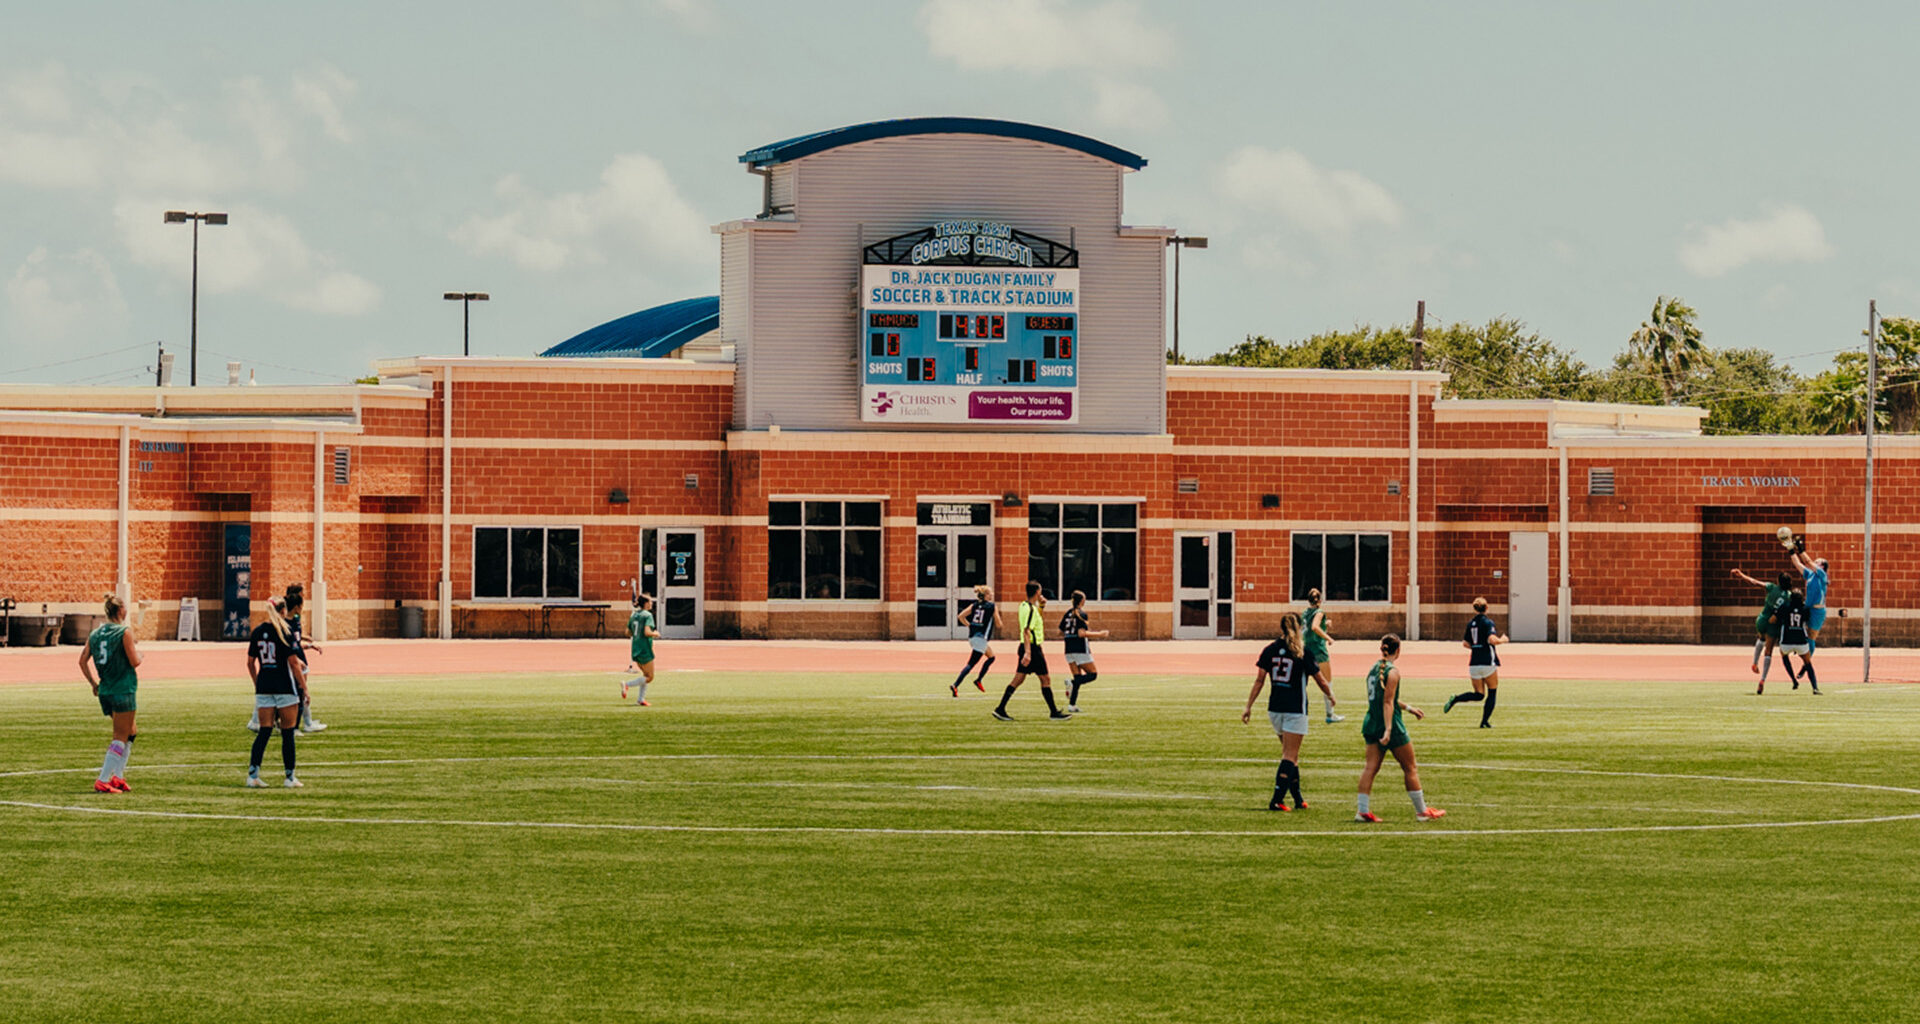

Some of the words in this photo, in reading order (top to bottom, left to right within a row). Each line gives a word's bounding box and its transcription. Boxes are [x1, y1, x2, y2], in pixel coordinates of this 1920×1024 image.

[934, 221, 978, 237] TEXAS
[982, 221, 1012, 239] A&M
[911, 235, 970, 265] CORPUS
[973, 235, 1033, 267] CHRISTI
[891, 271, 914, 285] DR.
[917, 271, 951, 285] JACK
[954, 272, 1001, 286] DUGAN
[1004, 273, 1055, 287] FAMILY
[872, 287, 931, 303] SOCCER
[935, 289, 945, 303] &
[950, 289, 1001, 304] TRACK
[1005, 290, 1073, 305] STADIUM
[871, 313, 917, 327] TAMUCC
[956, 315, 1004, 337] 4:02
[1029, 316, 1069, 329] GUEST
[887, 333, 899, 355] 0
[1059, 336, 1072, 358] 0
[869, 362, 903, 375] SHOTS
[924, 358, 936, 380] 3
[1040, 364, 1073, 377] SHOTS
[956, 373, 983, 384] HALF
[900, 394, 957, 405] CHRISTUS
[977, 396, 997, 404] Your
[998, 396, 1027, 405] health.
[1028, 396, 1050, 405] Your
[1050, 396, 1065, 405] life.
[1010, 407, 1027, 415] Our
[1028, 408, 1064, 417] purpose.
[1701, 476, 1745, 487] TRACK
[1750, 476, 1800, 487] WOMEN
[932, 504, 972, 514] ATHLETIC
[931, 514, 972, 525] TRAINING
[972, 609, 985, 624] 21
[1790, 613, 1802, 627] 19
[99, 640, 108, 665] 5
[1272, 656, 1294, 682] 23
